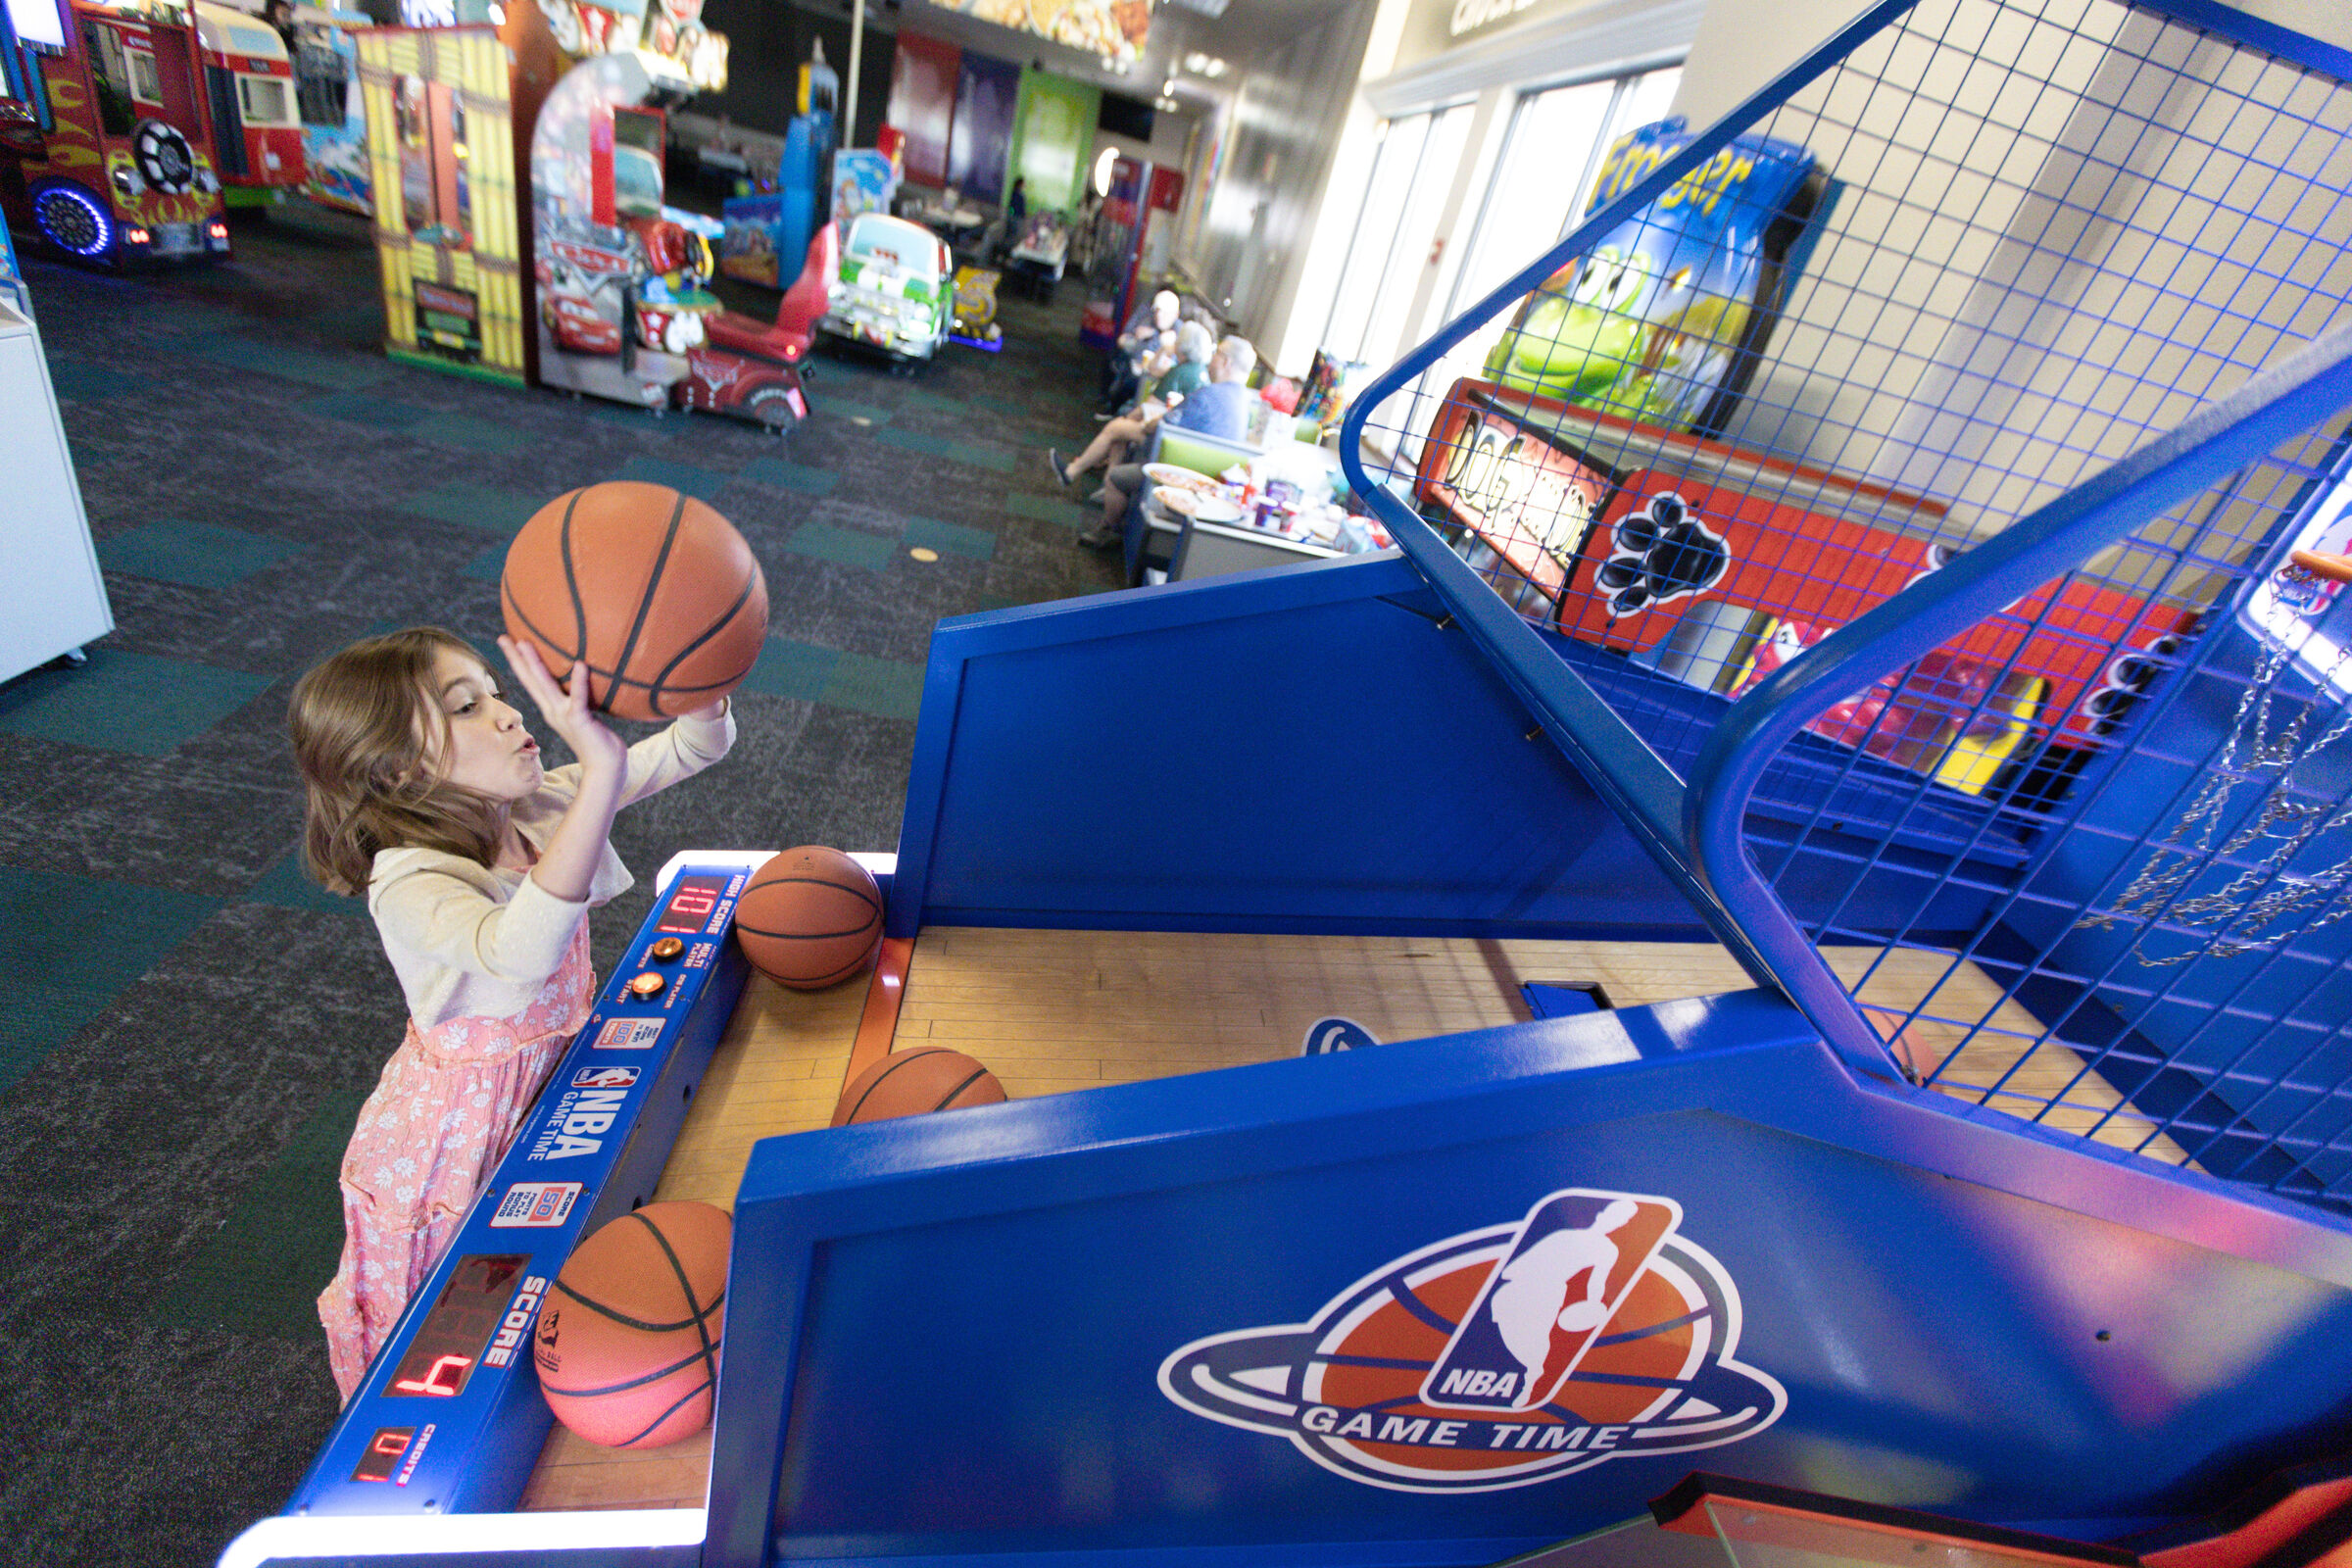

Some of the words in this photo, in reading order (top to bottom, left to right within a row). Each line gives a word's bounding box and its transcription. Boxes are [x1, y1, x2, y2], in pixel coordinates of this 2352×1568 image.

[725, 874, 745, 898] HIGH
[660, 886, 717, 934] 101
[706, 899, 733, 935] SCORE
[683, 942, 703, 968] PLAYER
[692, 942, 713, 968] MULTI
[615, 979, 635, 1005] START
[662, 987, 681, 1009] PLAYER
[612, 1022, 633, 1044] 100
[547, 1091, 579, 1128] GAME
[545, 1089, 628, 1160] NBA
[527, 1129, 559, 1161] TIME
[498, 1192, 515, 1218] ROUND
[506, 1192, 524, 1217] BONUS
[521, 1193, 538, 1216] POINTS
[522, 1191, 532, 1200] TO
[536, 1191, 560, 1217] 50
[558, 1191, 575, 1217] SCORE
[514, 1200, 527, 1218] PLAY
[482, 1275, 547, 1368] SCORE
[395, 1355, 472, 1396] 4
[1440, 1368, 1519, 1398] NBA
[1300, 1404, 1470, 1446] GAME
[1490, 1423, 1636, 1452] TIME
[396, 1423, 437, 1488] CREDITS
